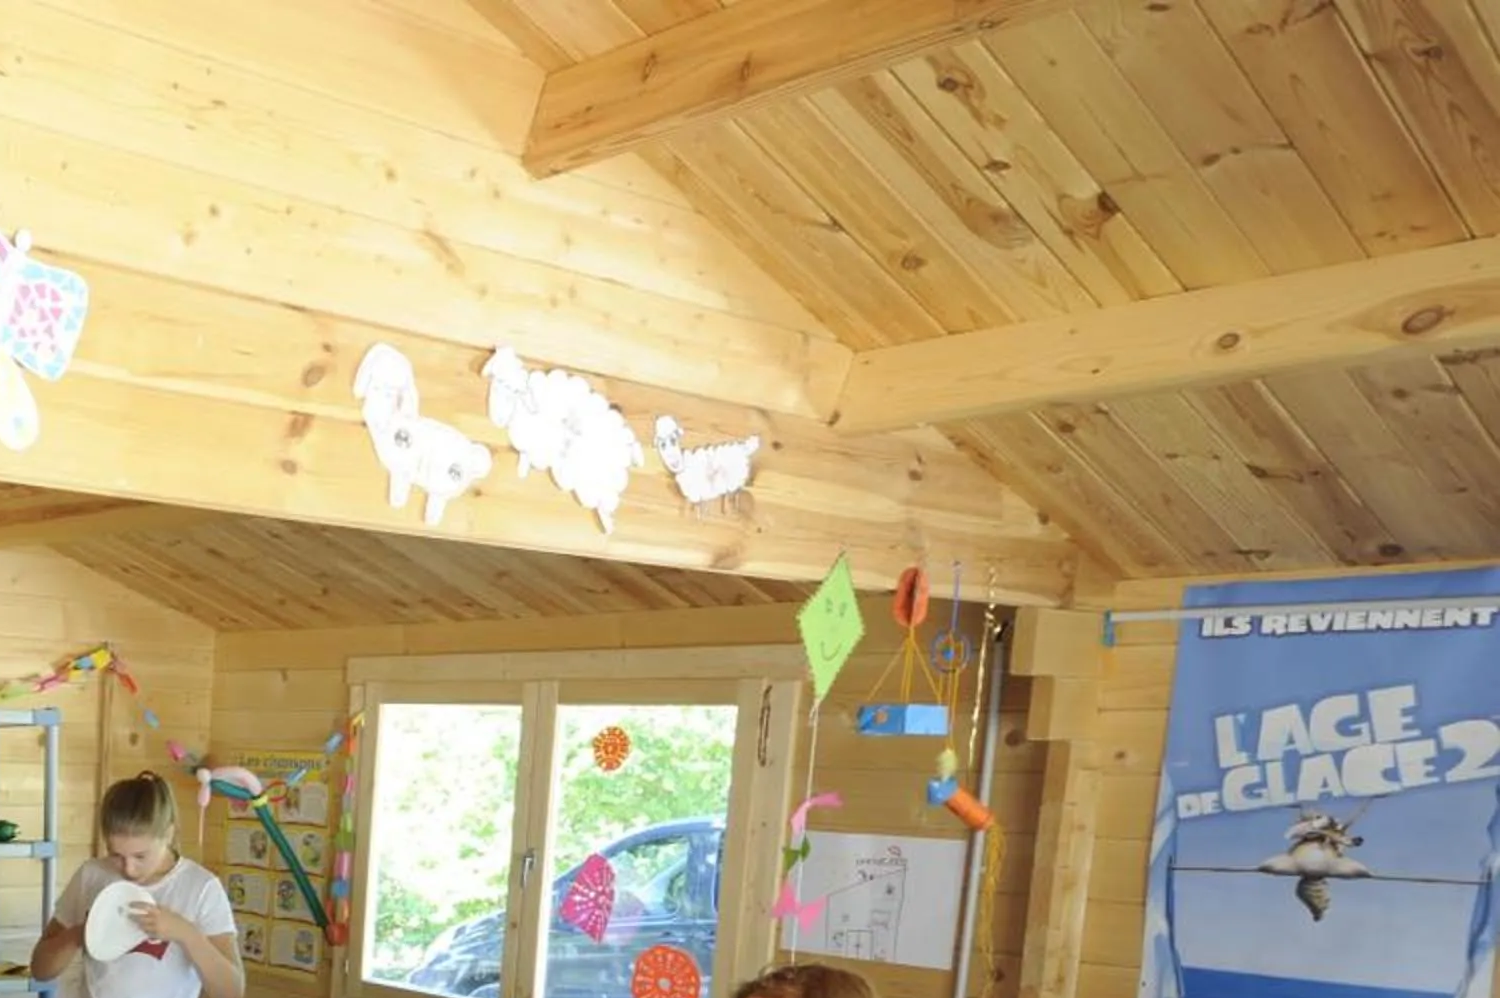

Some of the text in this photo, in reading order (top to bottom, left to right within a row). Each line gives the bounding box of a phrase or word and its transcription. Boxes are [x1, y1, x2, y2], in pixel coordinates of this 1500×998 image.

[1201, 606, 1498, 636] ILS REVIENNENT
[1177, 718, 1500, 820] DE GLACE 2
